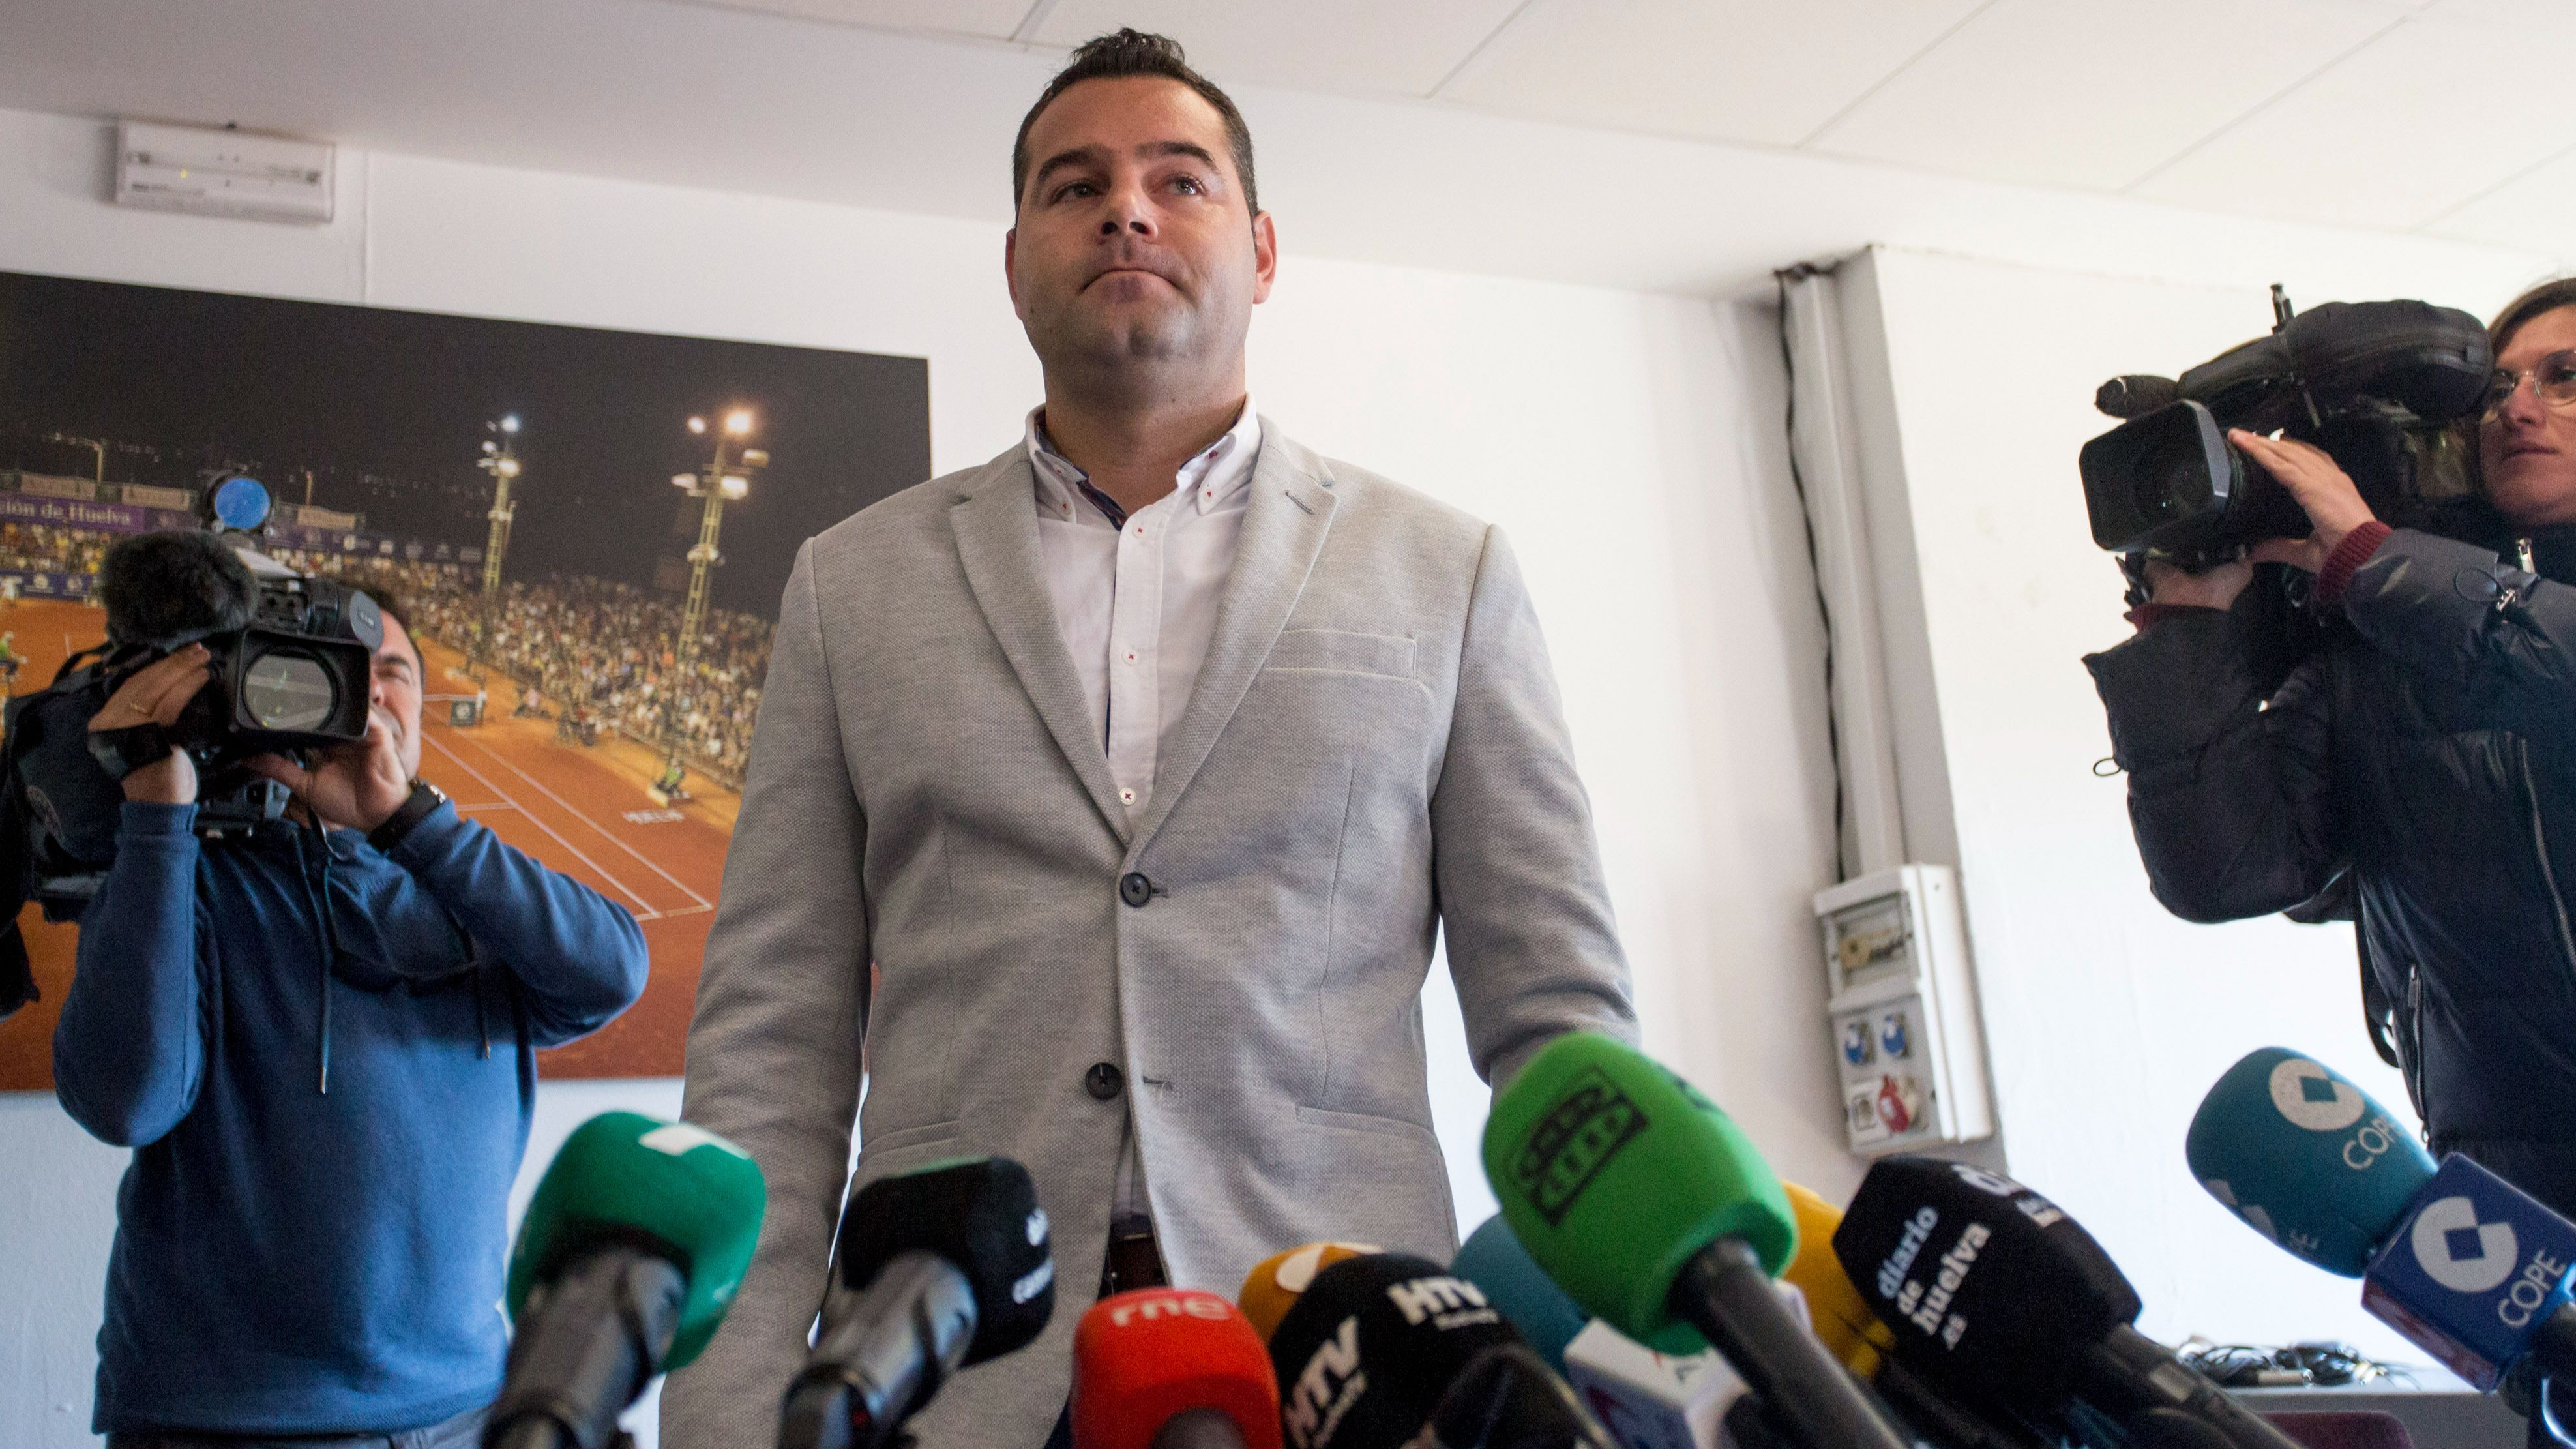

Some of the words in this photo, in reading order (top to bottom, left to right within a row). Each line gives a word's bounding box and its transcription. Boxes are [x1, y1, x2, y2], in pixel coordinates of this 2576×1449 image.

[40, 501, 64, 520] de
[68, 502, 131, 525] Huelva
[1878, 1206, 1938, 1300] diario
[1910, 1221, 1991, 1337] huelva
[1112, 1298, 1230, 1328] rne
[1386, 1276, 1487, 1326] HTV
[1897, 1279, 1923, 1316] de
[2498, 1249, 2567, 1328] COPE
[1283, 1314, 1361, 1449] HTV
